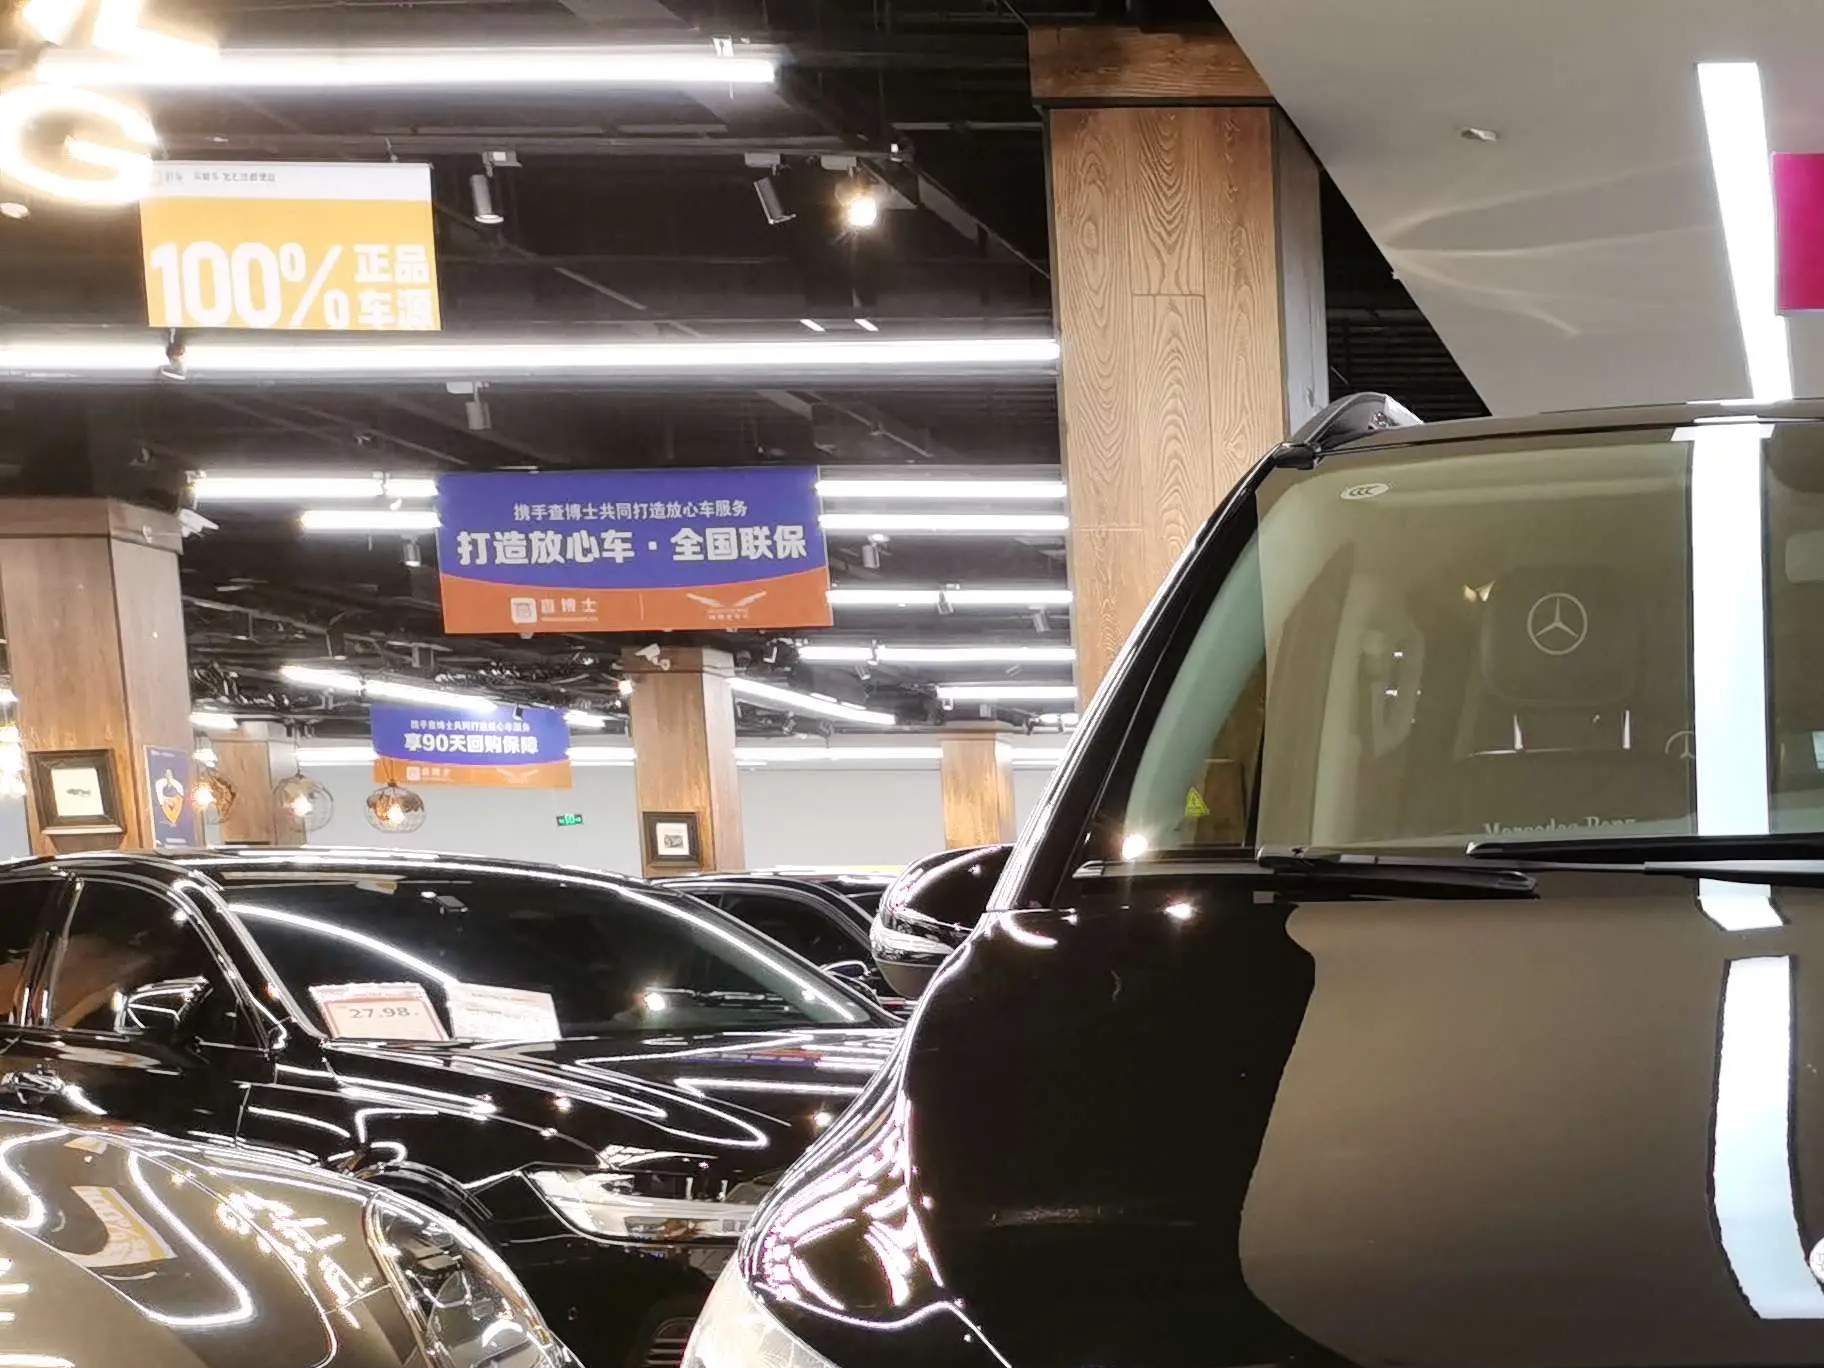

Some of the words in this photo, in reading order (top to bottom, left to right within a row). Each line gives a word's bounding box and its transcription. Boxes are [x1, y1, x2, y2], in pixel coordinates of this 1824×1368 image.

[353, 243, 431, 284] 正品
[150, 240, 350, 330] 100%
[357, 289, 437, 331] 车源
[513, 498, 748, 521] 携手查博士共同打造放心车服务
[404, 732, 539, 755] 享90天回购保障
